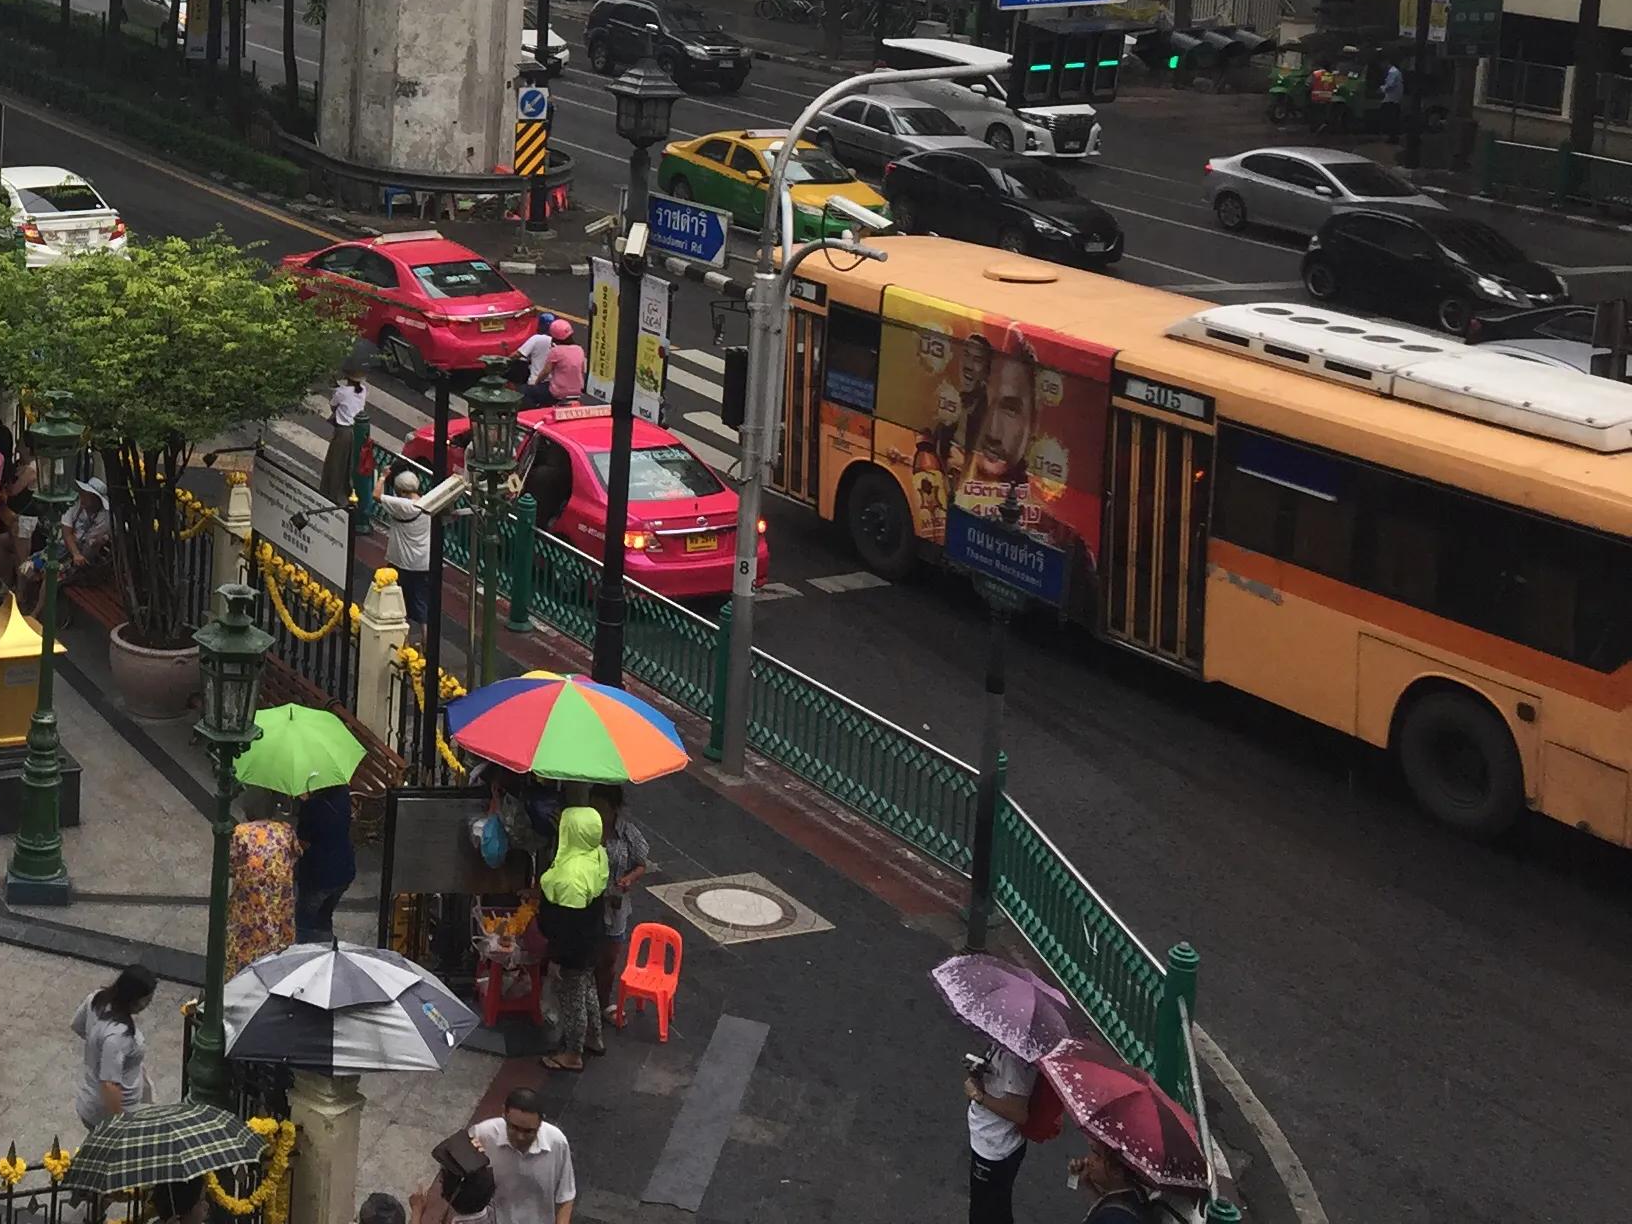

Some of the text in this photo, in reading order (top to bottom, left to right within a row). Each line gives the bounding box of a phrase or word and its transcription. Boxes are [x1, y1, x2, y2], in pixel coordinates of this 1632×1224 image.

[656, 207, 708, 238] ราชดำริ
[1145, 386, 1182, 409] 505
[967, 527, 1045, 573] ถนนราชดำริ
[739, 560, 749, 575] 8
